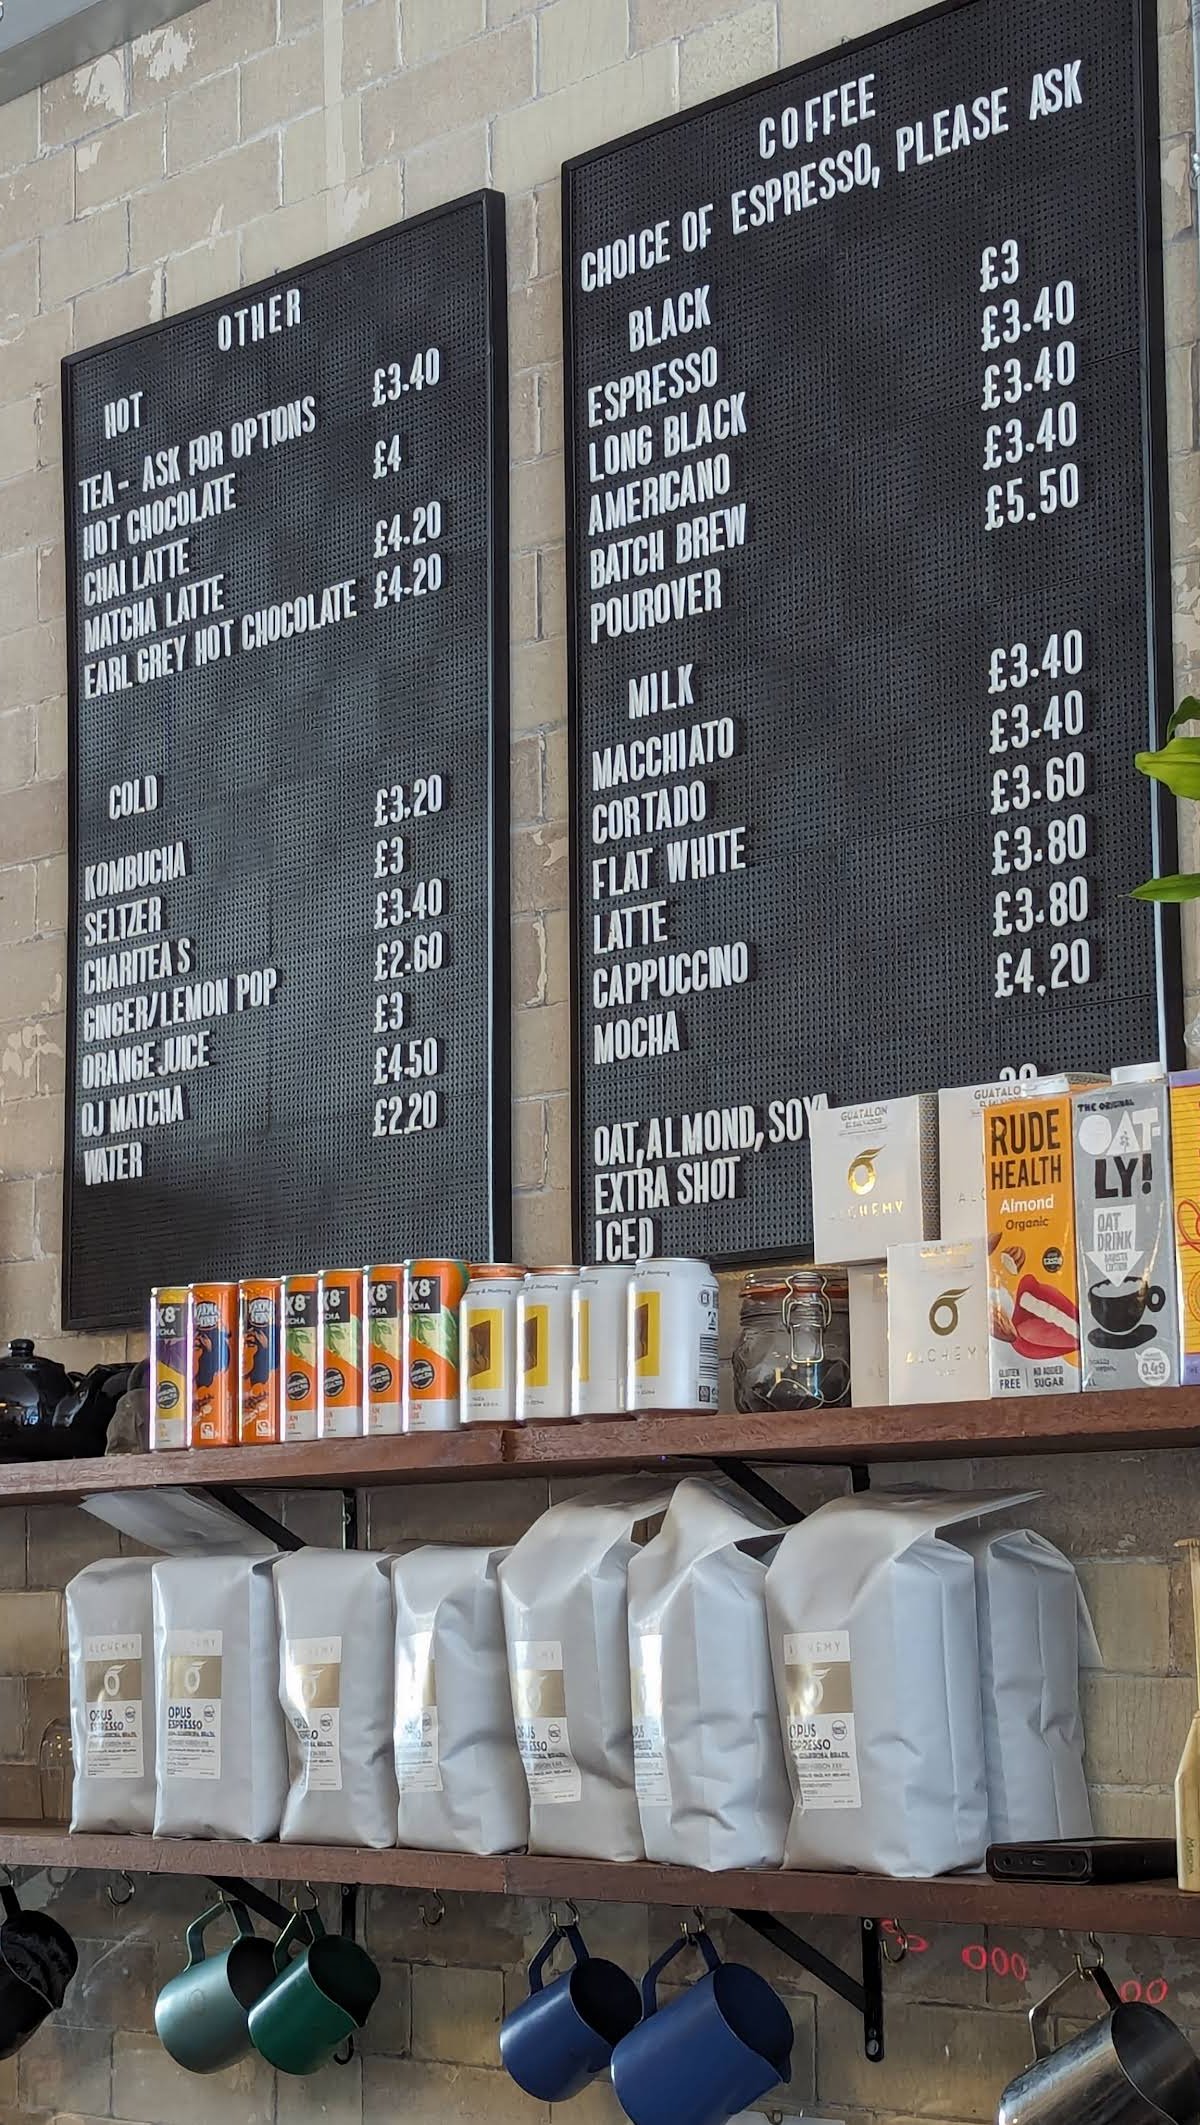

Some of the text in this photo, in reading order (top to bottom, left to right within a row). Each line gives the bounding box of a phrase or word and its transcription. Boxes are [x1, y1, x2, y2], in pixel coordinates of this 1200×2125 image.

[759, 73, 876, 160] COFFEE
[581, 59, 1083, 292] CHOICE OF ESPRESSO, PLEASE ASK
[979, 239, 1019, 293] £3
[217, 288, 301, 352] OTHER
[628, 284, 711, 353] BLACK
[981, 280, 1075, 352] £3.40
[372, 347, 440, 407] £3.40
[588, 346, 718, 428] ESPRESSO
[981, 340, 1075, 411] £3.40
[104, 391, 143, 440] HOT
[142, 445, 181, 492] ASK
[189, 430, 223, 476] FOR
[231, 395, 316, 459] OPTIONS
[588, 391, 747, 483] LONG BLACK
[982, 401, 1077, 471] £3.40
[373, 434, 401, 480] £4
[82, 472, 236, 561] HOT CHOCOLATE
[588, 453, 730, 536] AMERICANO
[984, 462, 1079, 532] £5.50
[373, 501, 441, 559] £4.20
[590, 503, 747, 590] BATCH BREW
[83, 537, 190, 607] CHAI LATTE
[374, 553, 441, 609] £4.20
[84, 573, 224, 654] MATCHA LATTE
[590, 568, 722, 644] POUROVER
[84, 579, 357, 700] EARL GREY HOT CHOCOLATE
[988, 629, 1083, 694] £3.40
[628, 663, 694, 719] MILK
[988, 689, 1083, 754] £3.40
[592, 717, 734, 791] MACCHIATO
[990, 751, 1085, 815] £3.60
[109, 775, 158, 820] COLD
[592, 780, 706, 845] CORTADO
[84, 841, 186, 901] KOMBUCHA
[373, 836, 404, 879] £3
[592, 826, 746, 900] FLAT WHITE
[991, 813, 1087, 876] £3.80
[84, 896, 162, 947] SELTZER
[374, 878, 442, 930] £3.40
[593, 900, 668, 955] LATTE
[992, 876, 1088, 937] £3.80
[374, 931, 443, 982] £2.60
[593, 941, 748, 1009] CAPPUCCINO
[236, 968, 277, 1011] POP
[373, 991, 404, 1034] £3
[82, 1030, 210, 1089] ORANGE JUICE
[373, 1037, 438, 1085] £4.50
[594, 1010, 680, 1065] MOCHA
[81, 1085, 184, 1137] OJ MATCHA
[990, 1109, 1061, 1157] RUDE
[1077, 1104, 1097, 1113] THE
[84, 1141, 143, 1186] WATER
[595, 1156, 740, 1215] EXTRA SHOT
[991, 1155, 1062, 1191] HEALTH
[1094, 1153, 1153, 1199] LY!
[999, 1193, 1055, 1214] Almond
[1005, 1216, 1049, 1232] Organic
[1097, 1212, 1121, 1232] OAT
[595, 1217, 653, 1262] ICED
[1097, 1231, 1133, 1252] DRINK
[999, 1376, 1064, 1390] FREE SUGAR
[168, 1706, 192, 1719] OPUS
[168, 1719, 203, 1730] ESPRESSO
[789, 1723, 817, 1738] OPUS
